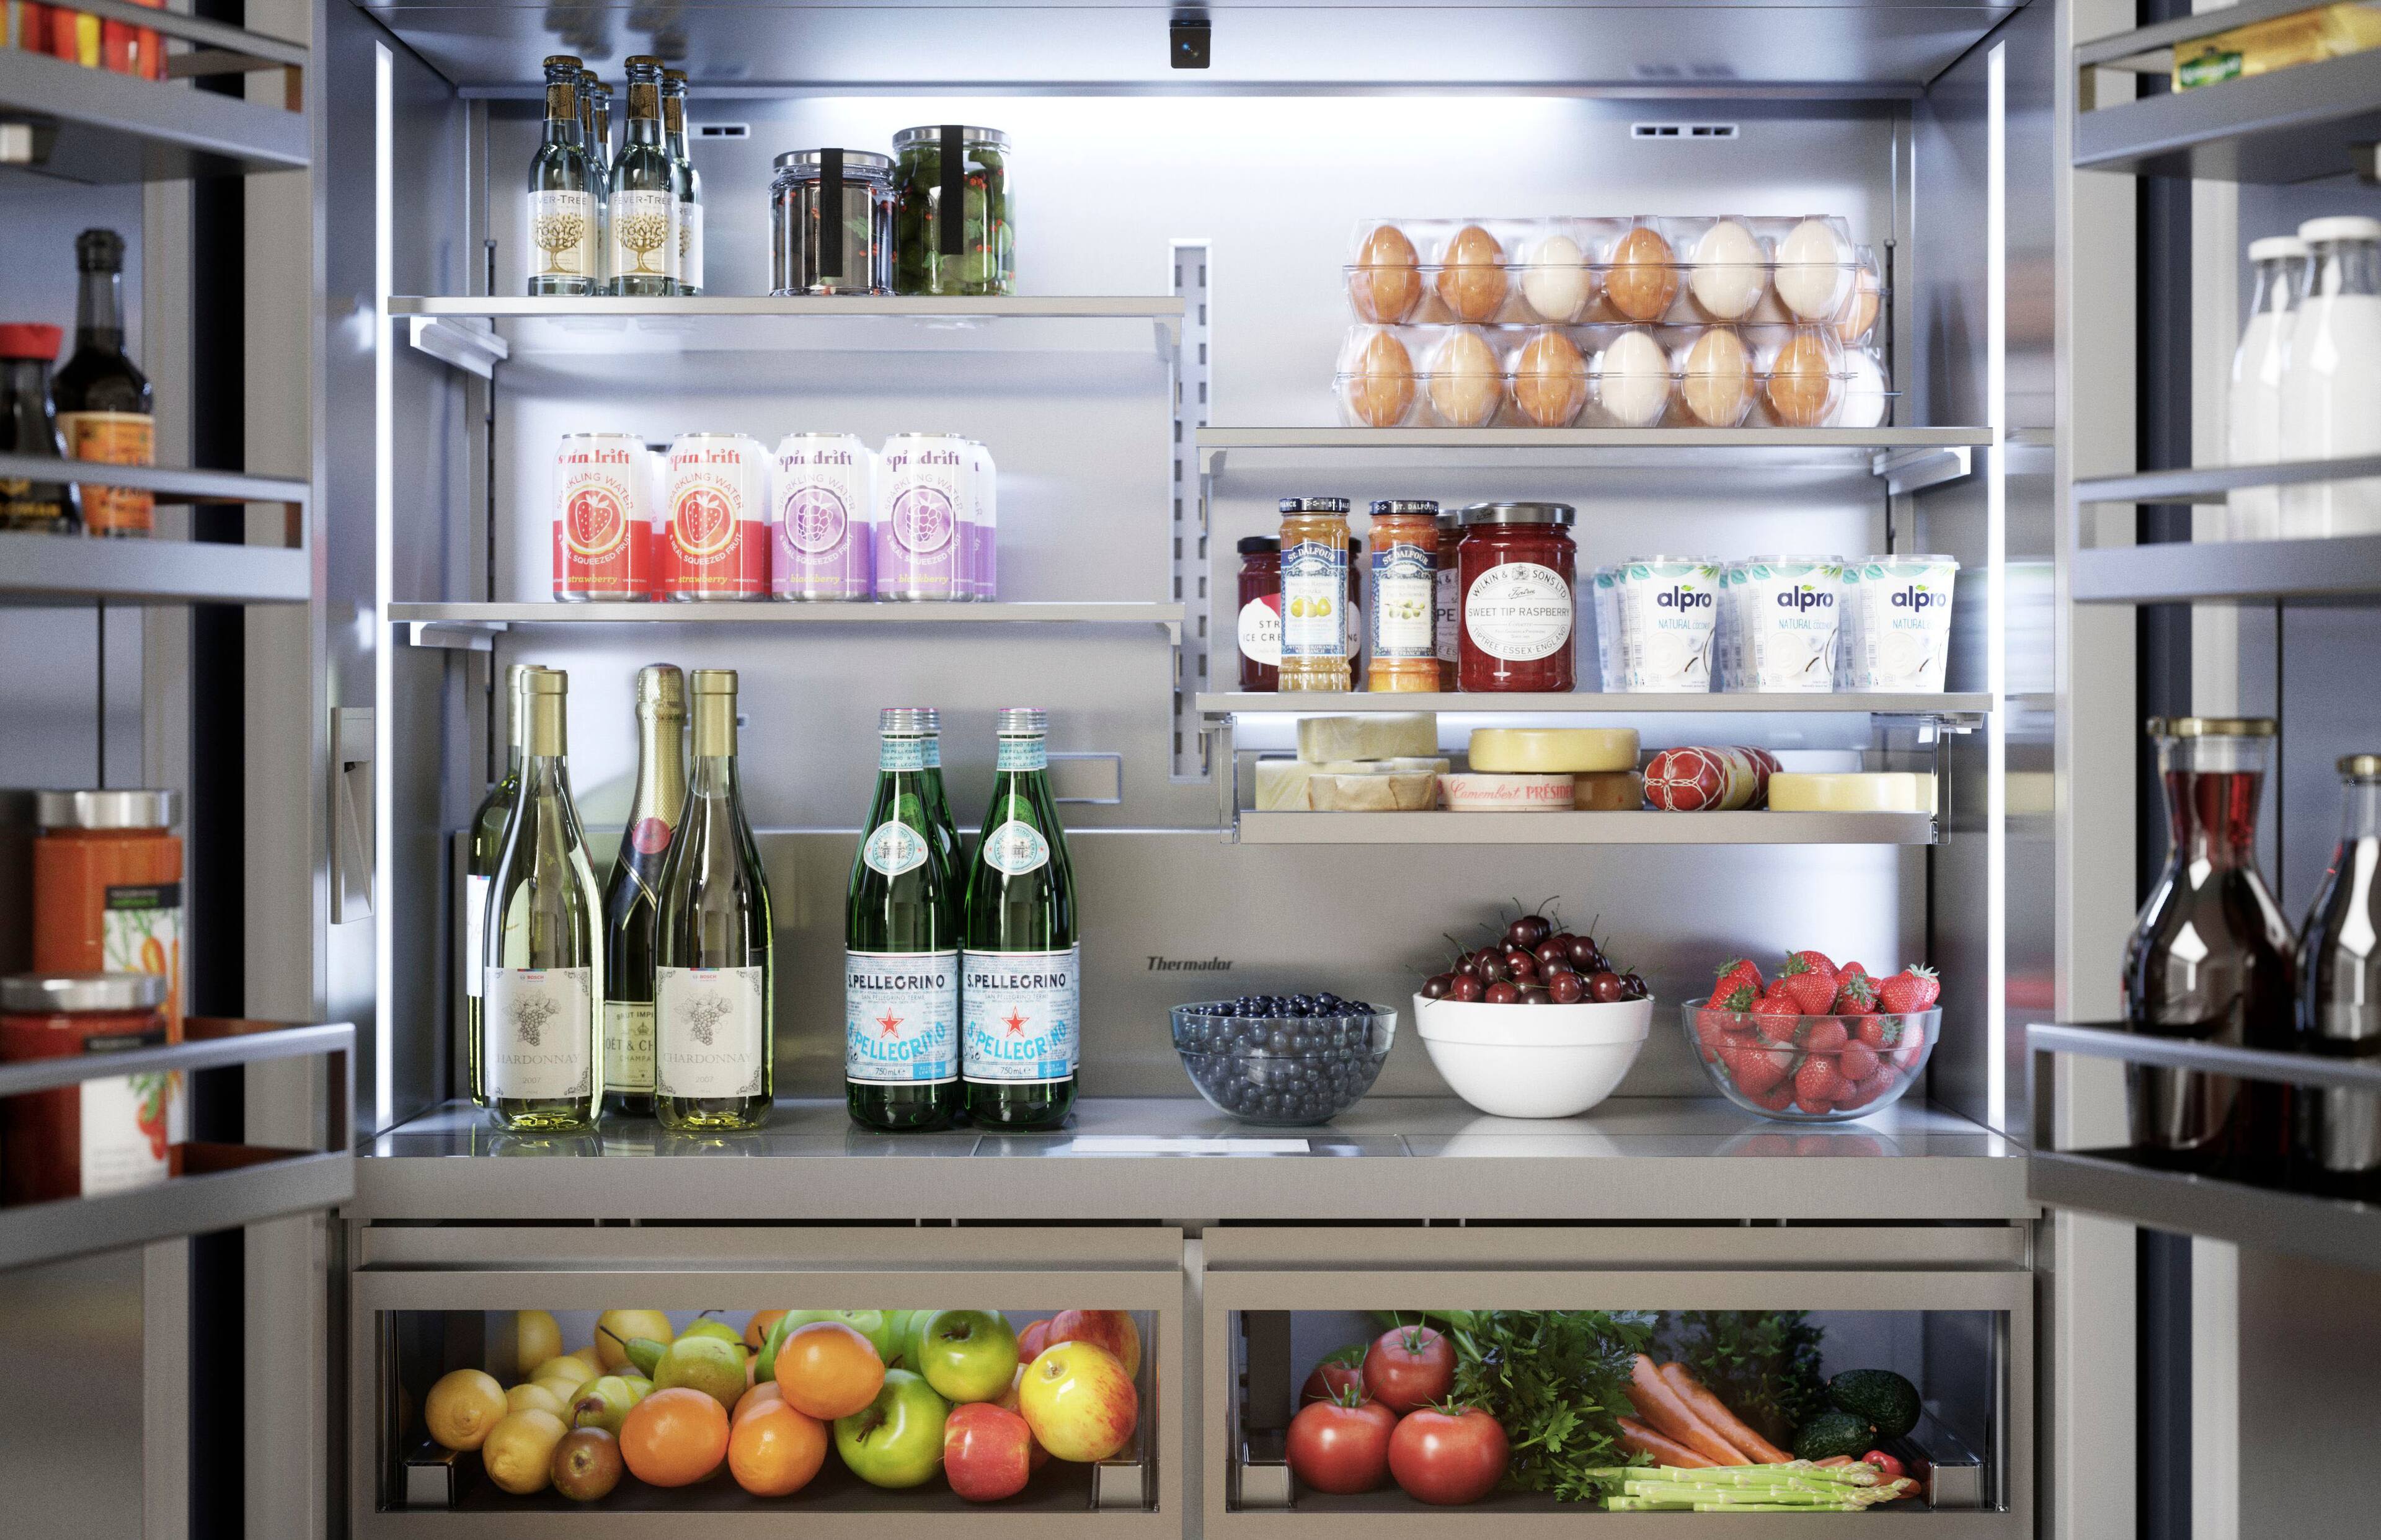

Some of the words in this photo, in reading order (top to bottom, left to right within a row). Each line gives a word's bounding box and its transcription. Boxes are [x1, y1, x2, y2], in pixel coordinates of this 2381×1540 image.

[531, 195, 587, 205] VER-TREE
[614, 195, 671, 205] FEVER-TREE
[536, 226, 576, 236] TONIC
[620, 226, 662, 236] TONIC
[535, 238, 578, 249] WATER
[620, 239, 663, 249] WATER
[558, 448, 631, 464] sinrift
[886, 449, 960, 472] spidrift
[605, 476, 634, 510] WATER
[668, 472, 711, 509] SPARKLING
[716, 476, 744, 510] WATER
[778, 474, 824, 510] SPARKLING
[884, 474, 933, 511] SPARKLNG
[572, 551, 616, 565] SQUEEZED
[616, 532, 631, 555] FRUIT
[672, 541, 683, 560] REAL
[683, 552, 726, 565] SQUEEZED
[725, 532, 743, 555] FRUIT
[796, 553, 839, 565] SQUEEZED
[1287, 551, 1298, 563] ST.
[1298, 547, 1336, 562] DALFOUR
[1394, 549, 1429, 565] DALFOUR
[567, 573, 618, 585] strawberry
[678, 573, 728, 585] strawberry
[790, 573, 840, 585] blaberry
[1473, 573, 1499, 597] WILKIN
[1501, 570, 1508, 578] &
[1532, 570, 1554, 586] SONS
[1555, 582, 1567, 598] LTD
[1657, 585, 1712, 613] alpro
[1777, 585, 1833, 613] alpro
[1891, 585, 1946, 613] alpro
[1468, 608, 1497, 617] SWEET
[1501, 608, 1516, 616] TIP
[1519, 608, 1570, 616] RASPBERRY
[1658, 618, 1692, 629] NATURAL
[1779, 618, 1812, 629] NATURAL
[1892, 618, 1925, 629] NATURAL
[1473, 627, 1501, 651] TIPTREE
[1502, 645, 1532, 655] ESSEX
[1535, 626, 1567, 653] ENGLAND
[1450, 779, 1520, 800] Camembert
[1147, 956, 1233, 971] Thermador
[848, 974, 945, 990] S.PELLEGRINO
[967, 973, 1066, 989] S.PELLEGRINO
[616, 1012, 634, 1020] BRUT
[626, 1040, 634, 1051] &
[496, 1054, 580, 1065] HARDONNAY
[663, 1053, 752, 1064] CHARDONNAY
[876, 1067, 887, 1076] 750
[1001, 1066, 1013, 1075] 750
